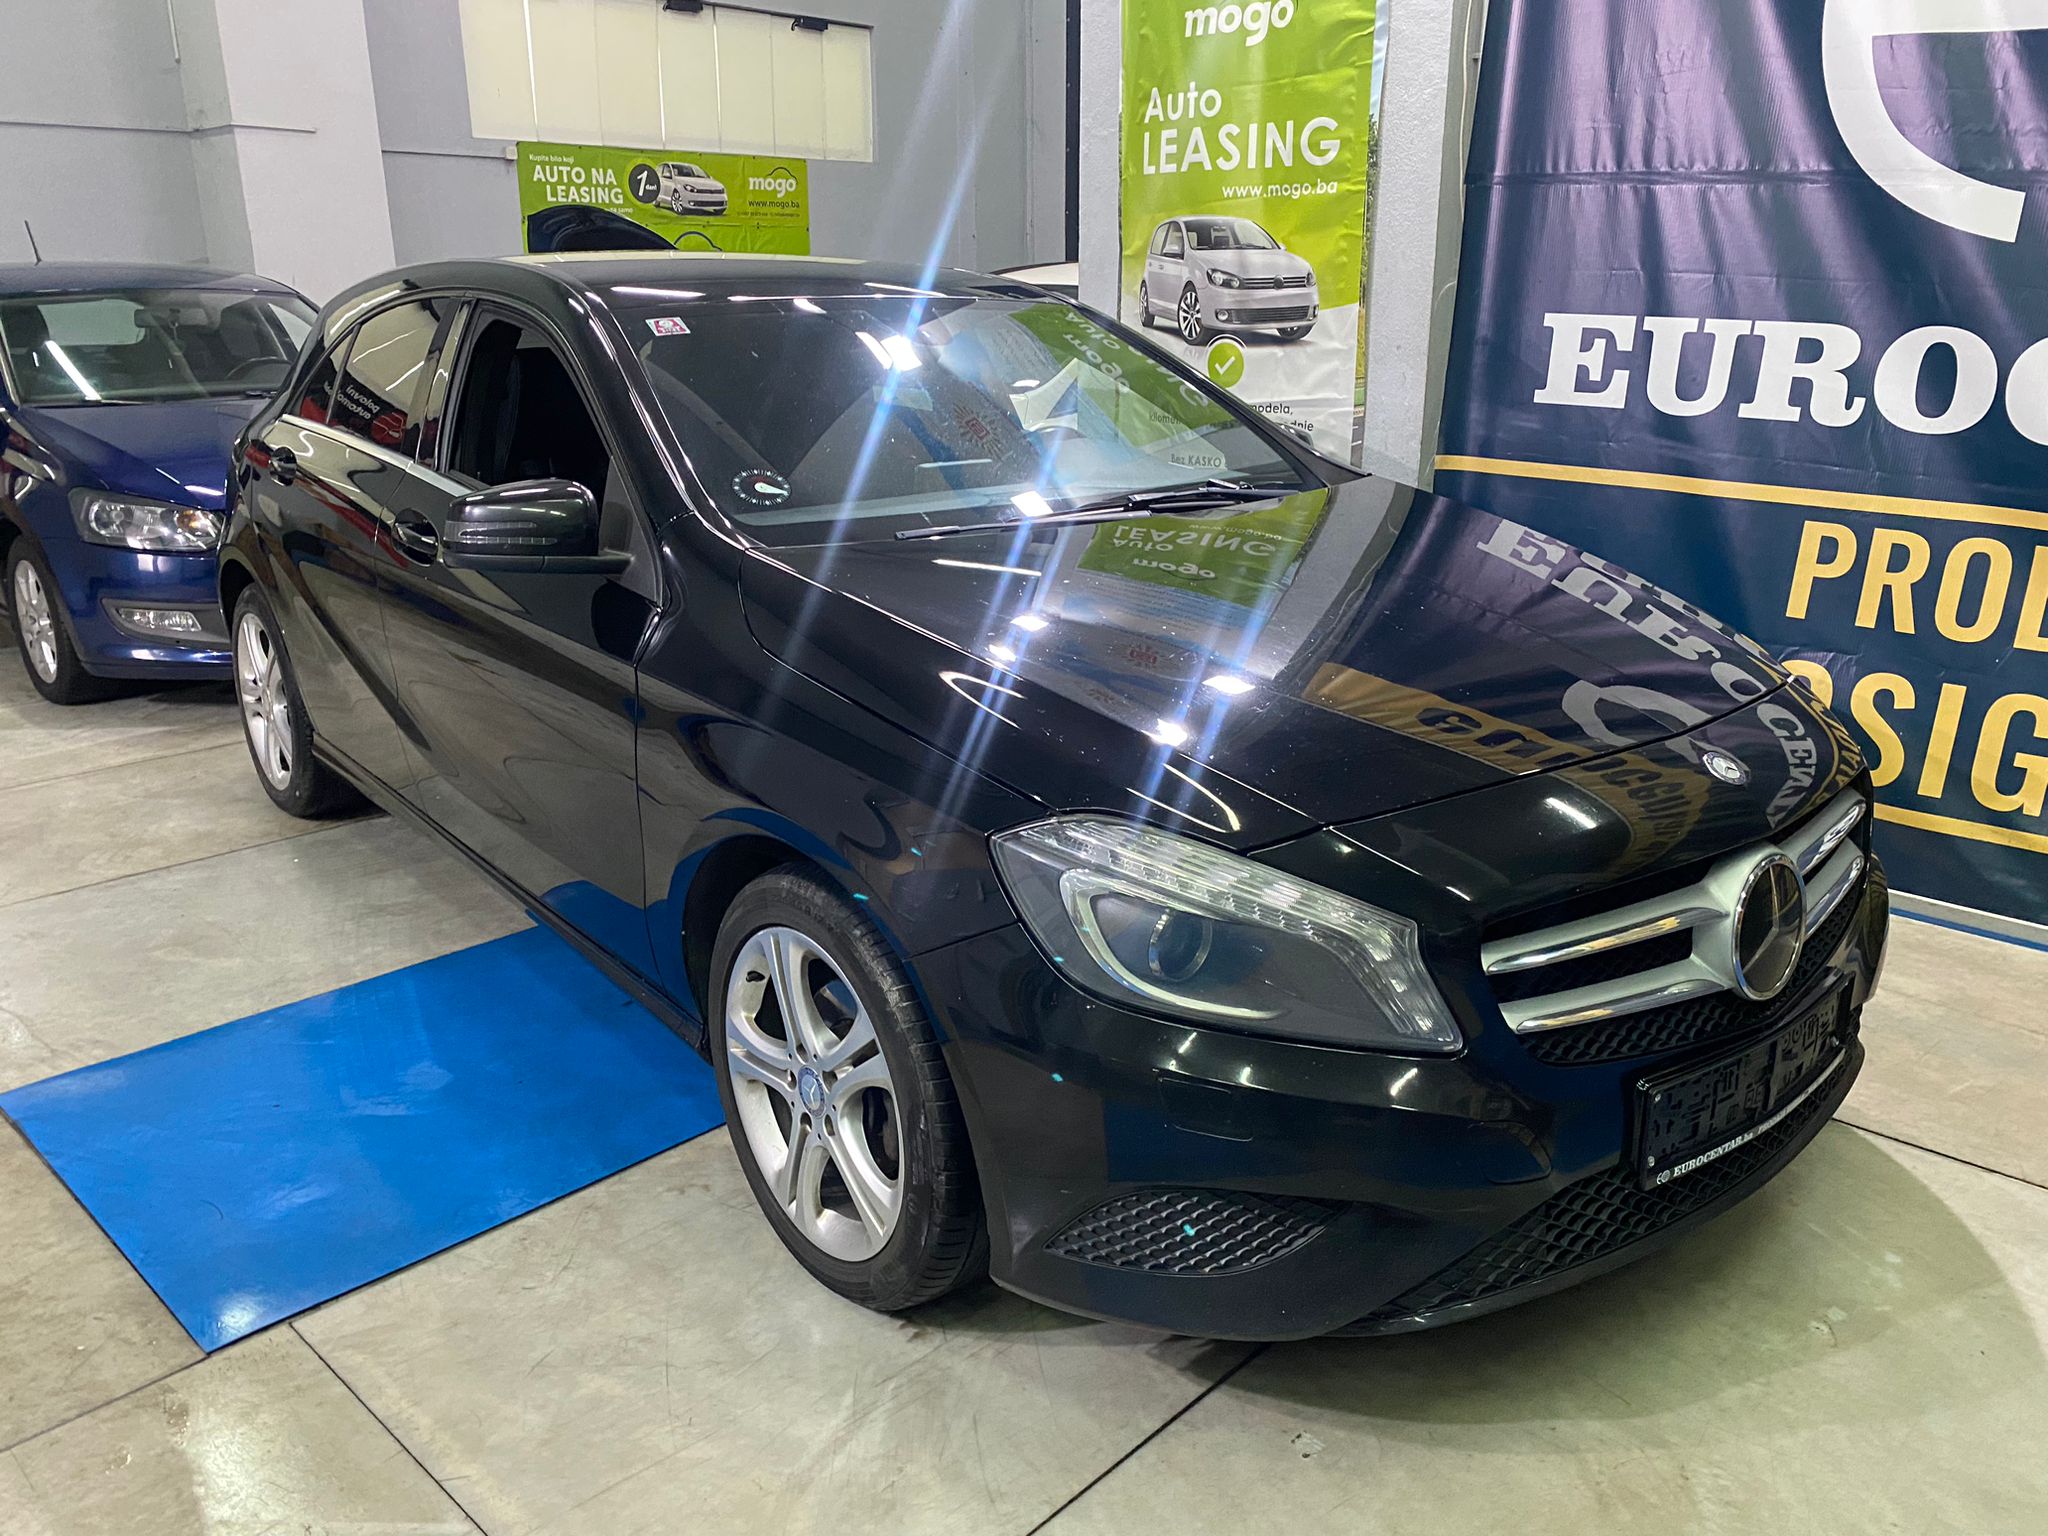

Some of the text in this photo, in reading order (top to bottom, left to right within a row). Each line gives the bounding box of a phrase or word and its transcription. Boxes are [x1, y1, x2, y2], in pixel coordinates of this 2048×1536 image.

[1184, 0, 1294, 47] mogo
[1144, 81, 1222, 123] Auto
[1143, 117, 1341, 175] LEASING
[533, 165, 617, 185] AUTO NA
[546, 185, 624, 204] LEASING
[748, 177, 796, 198] mogo
[1222, 179, 1338, 199] www.mogo.ba
[748, 200, 800, 209] www.mogo.ba
[1188, 454, 1222, 468] KASKO
